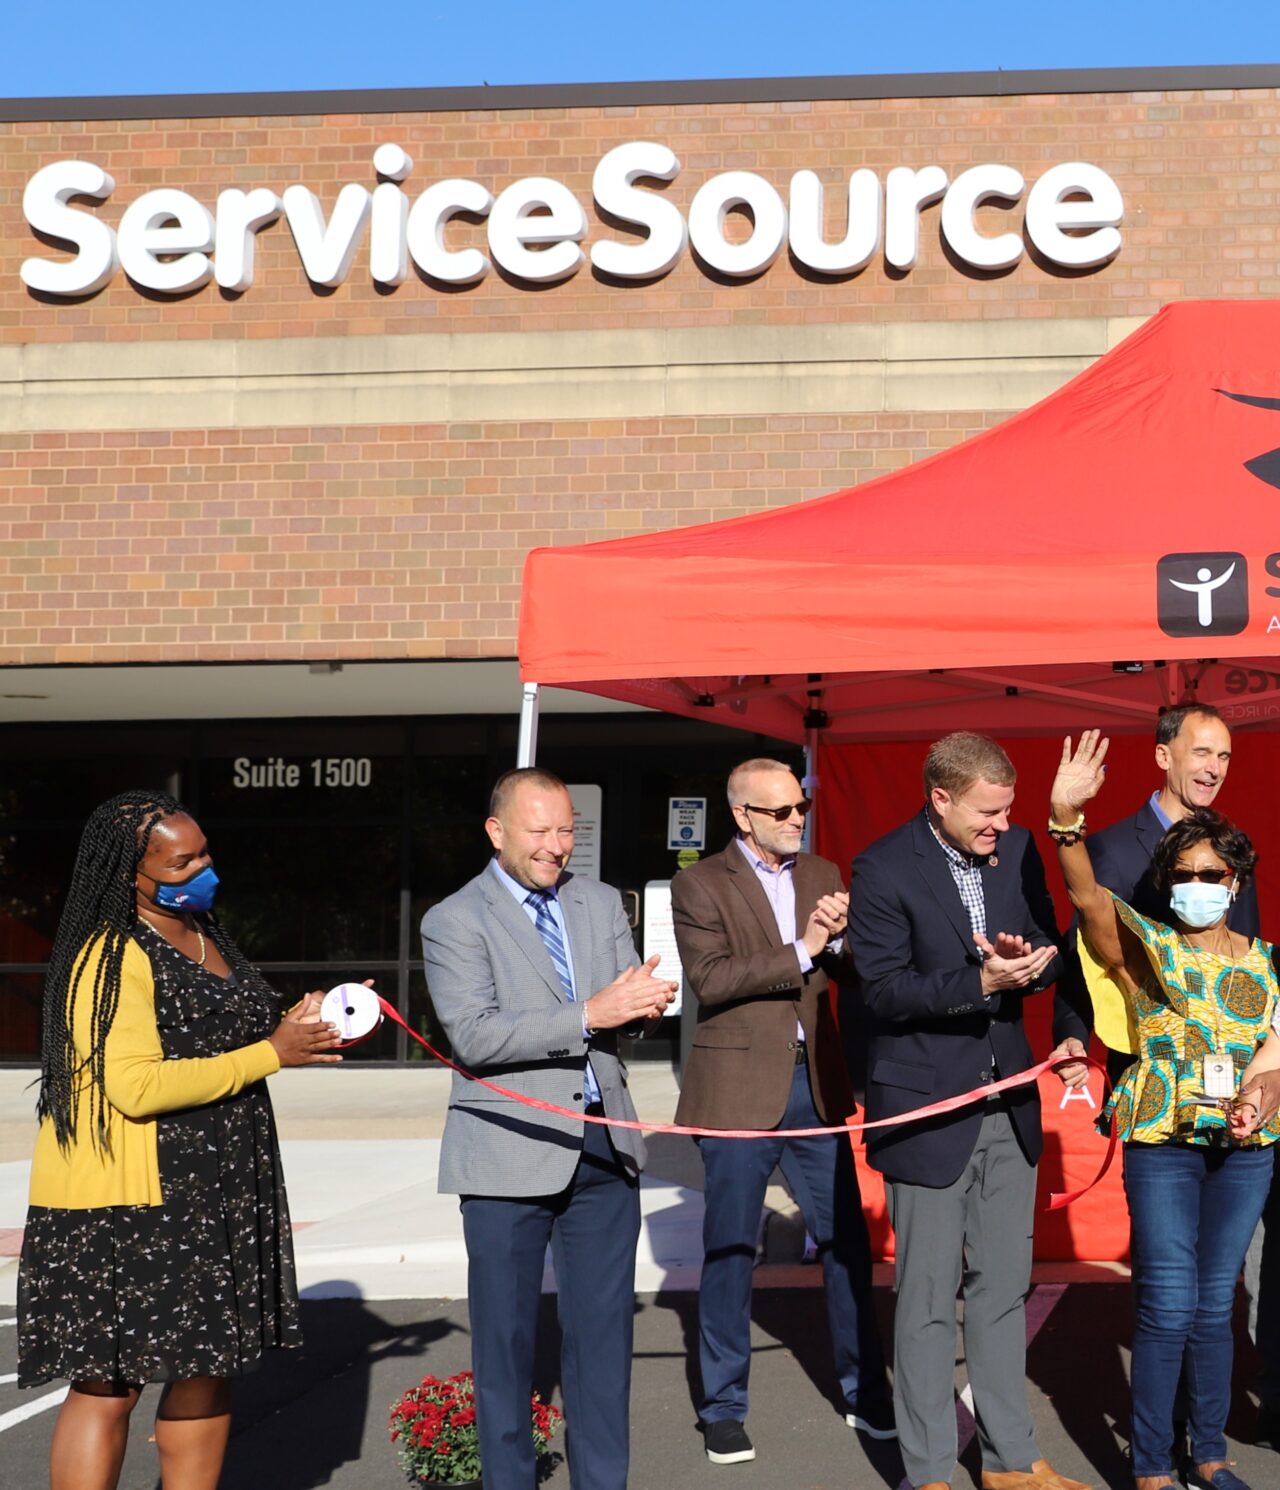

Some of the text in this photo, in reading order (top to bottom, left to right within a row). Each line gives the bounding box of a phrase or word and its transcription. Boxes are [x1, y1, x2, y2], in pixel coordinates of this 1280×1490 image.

[20, 141, 1125, 296] ServiceSource
[233, 757, 372, 788] Suite 1500
